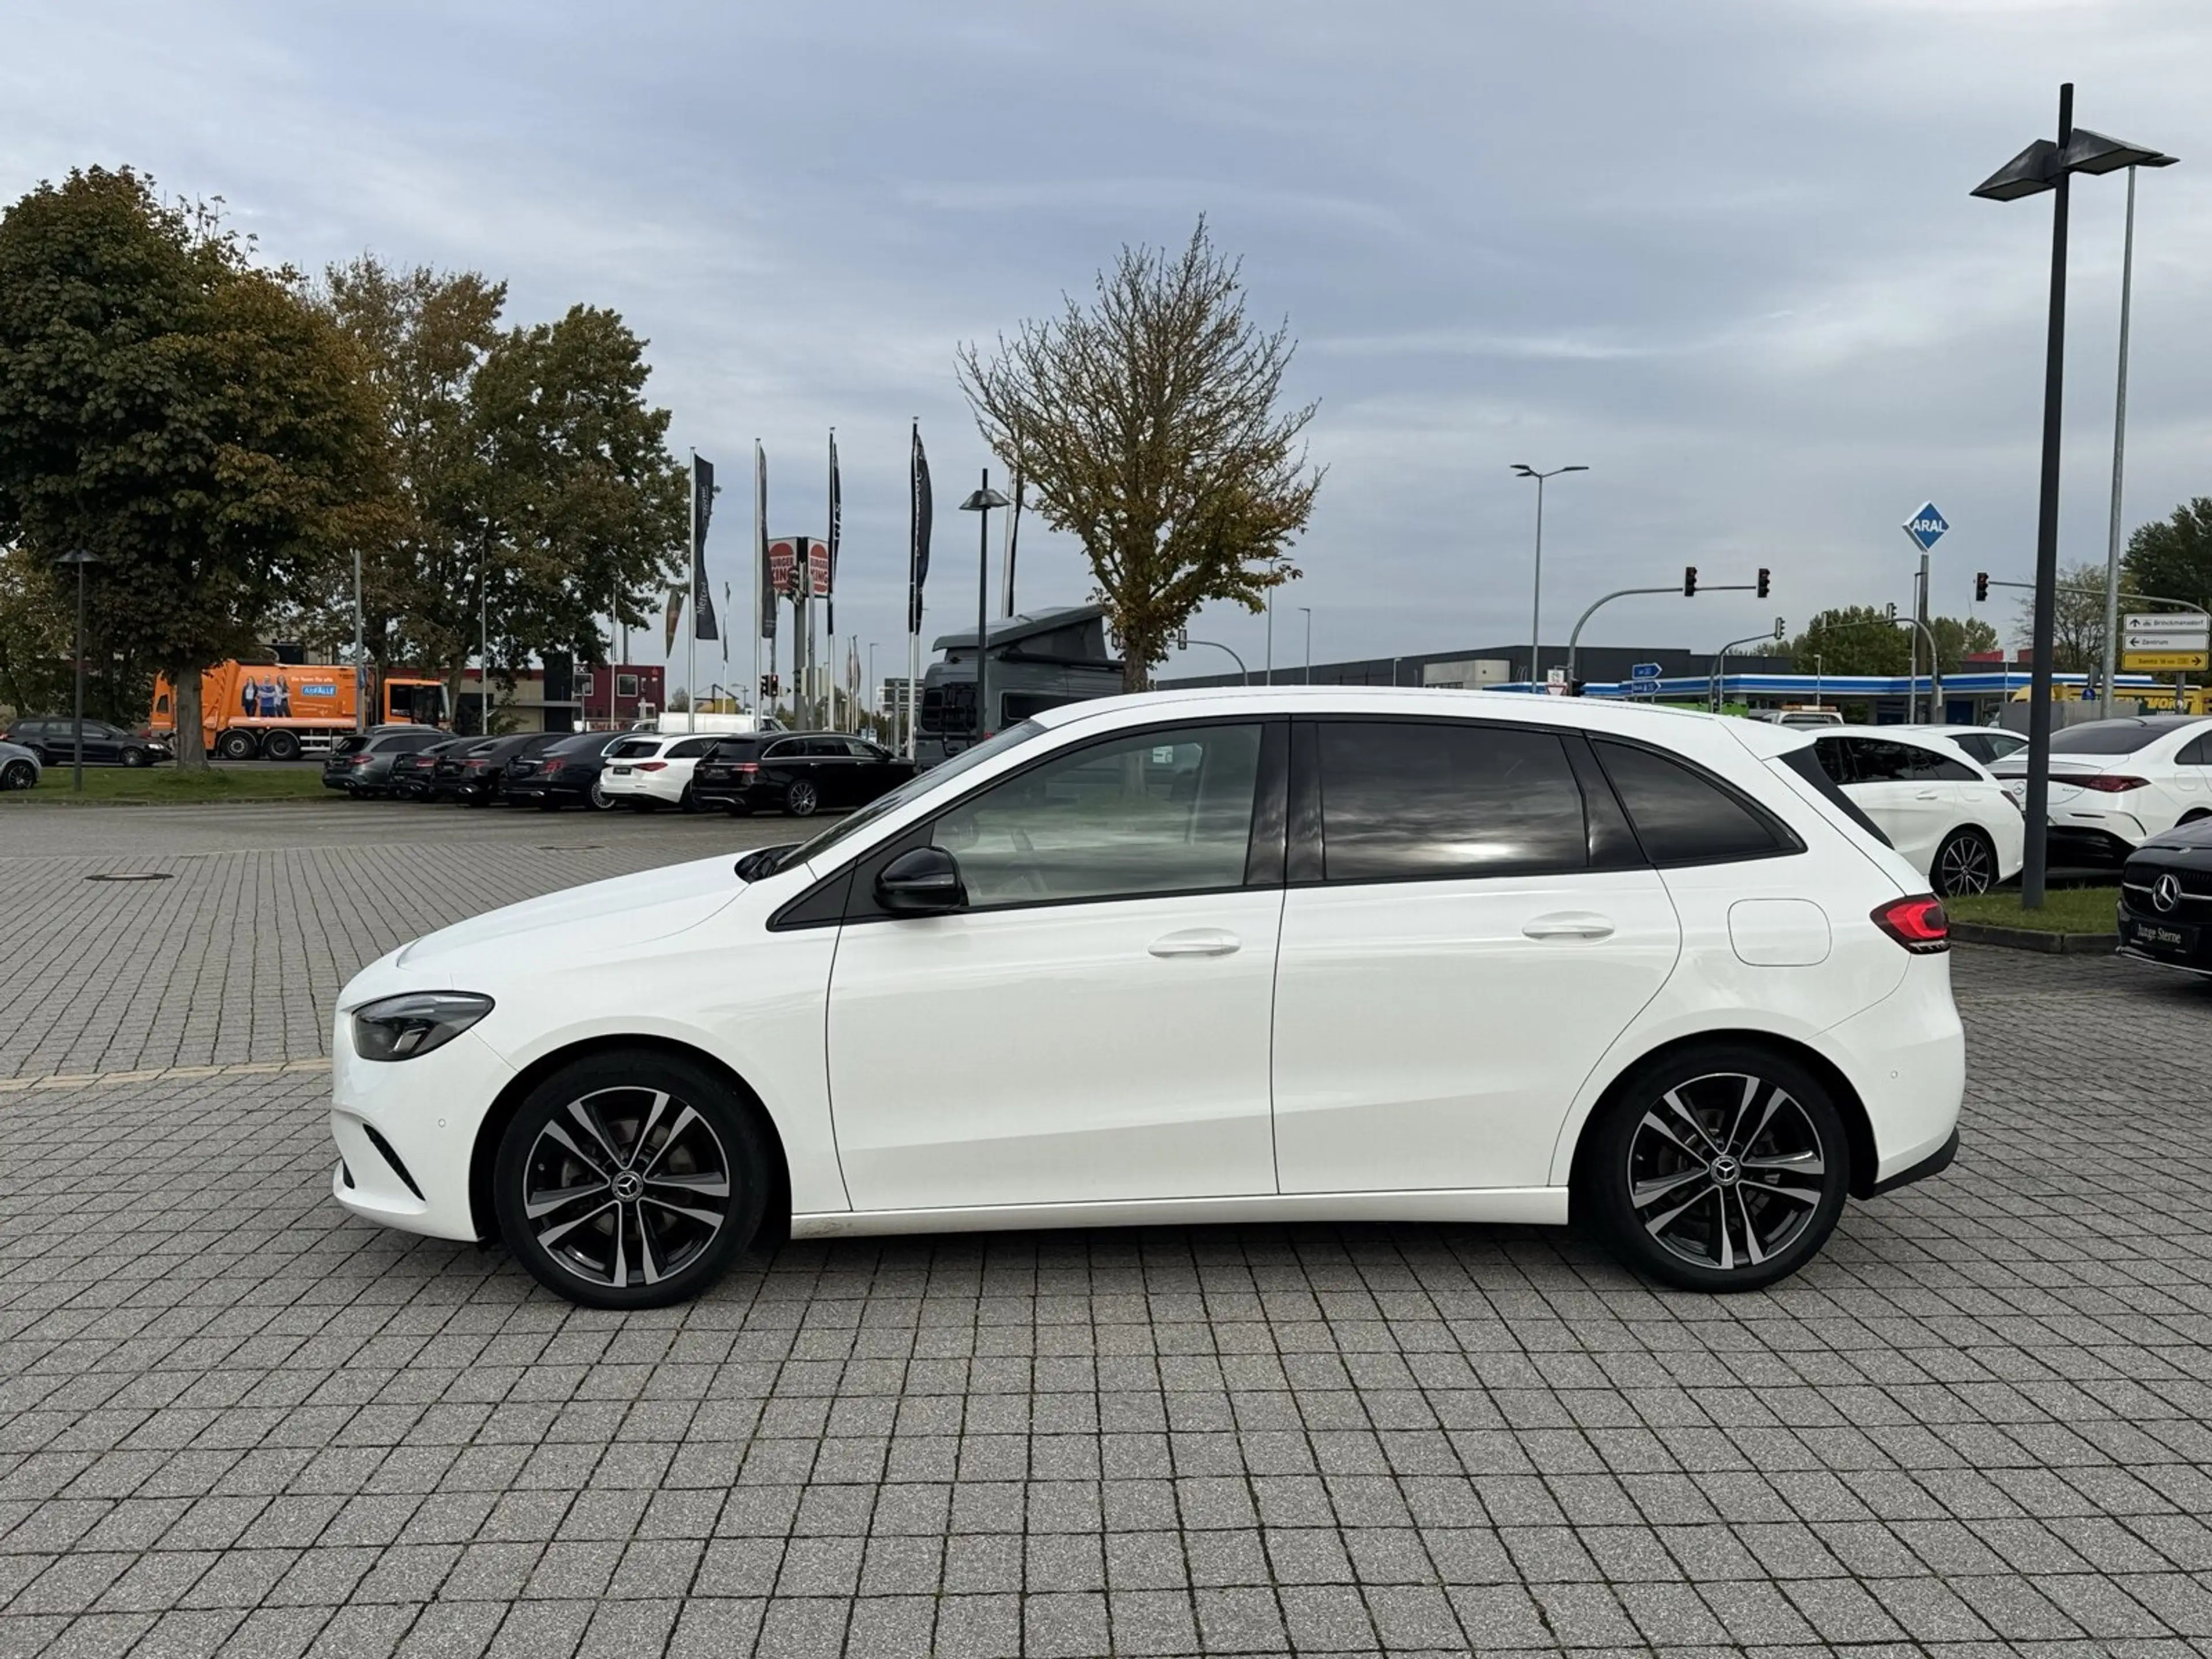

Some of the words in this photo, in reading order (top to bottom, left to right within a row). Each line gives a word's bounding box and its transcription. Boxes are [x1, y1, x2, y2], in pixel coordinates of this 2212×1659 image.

[1912, 518, 1946, 532] ARAL
[2137, 923, 2156, 941] Junge
[2157, 927, 2181, 944] Sterne
